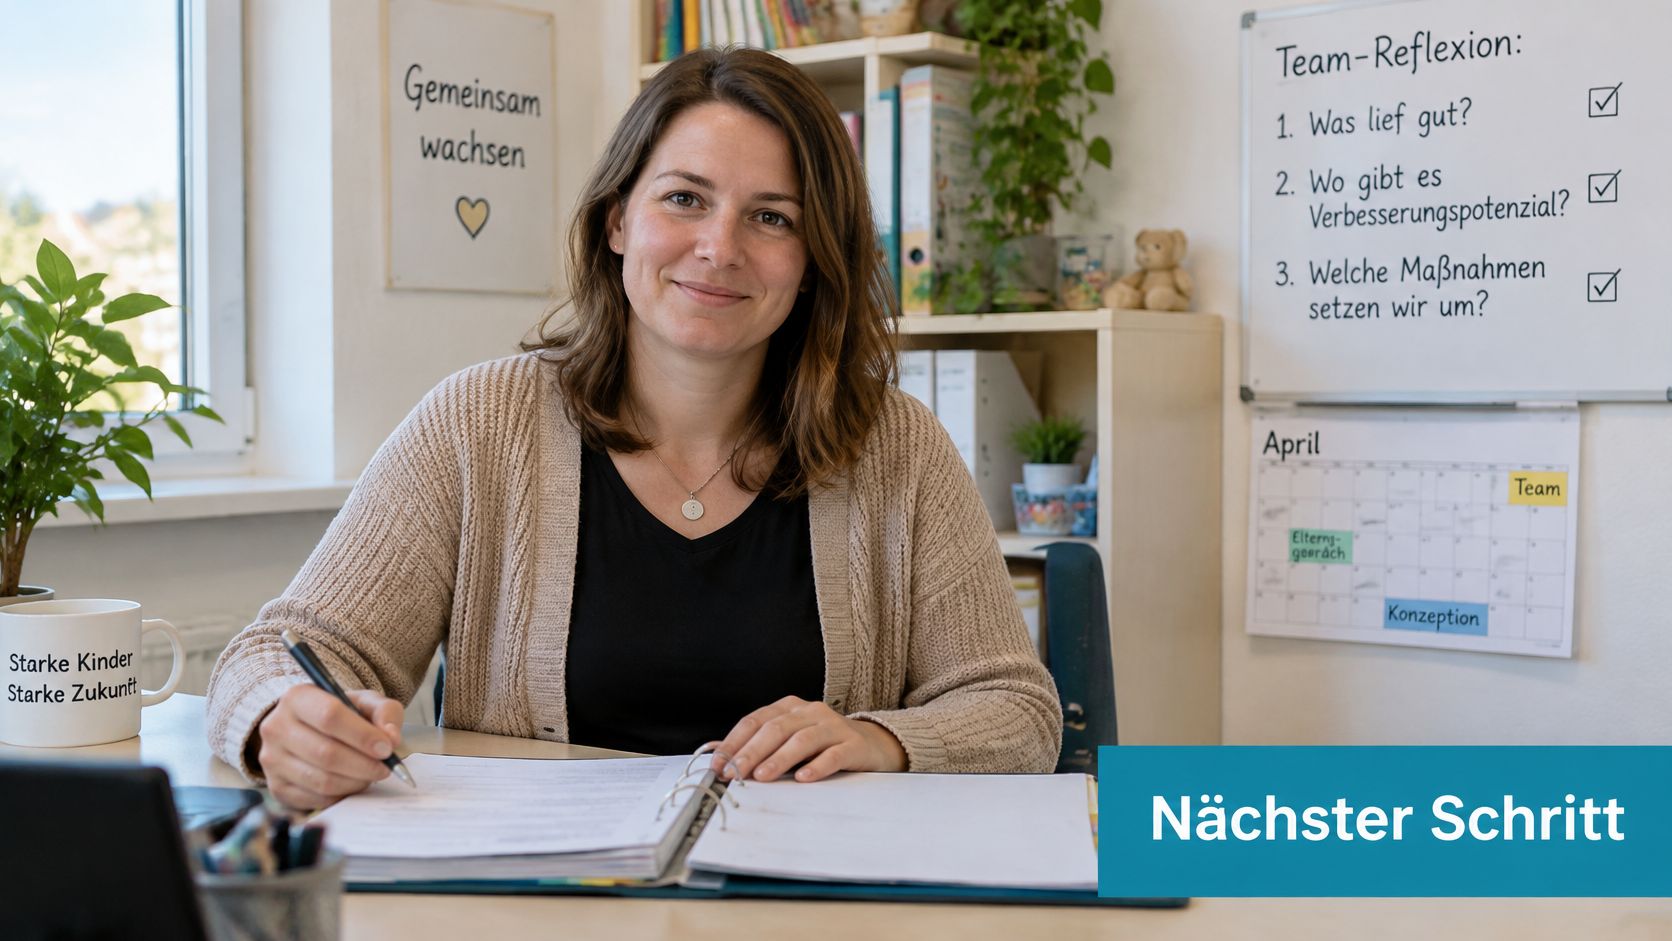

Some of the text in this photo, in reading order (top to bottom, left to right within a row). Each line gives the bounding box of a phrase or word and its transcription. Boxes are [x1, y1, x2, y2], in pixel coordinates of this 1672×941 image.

[1275, 30, 1522, 78] Team-Reflexion:
[404, 63, 541, 117] Gemeinsam
[1276, 96, 1473, 139] 1. Was lief gut?
[420, 129, 526, 169] wachsen
[1275, 163, 1442, 201] 2. Wo gibt es
[1309, 189, 1570, 231] Verbesserungspotenzial?
[1275, 254, 1546, 289] 3. Welche Maßnahmen
[1309, 290, 1489, 320] setzen wir um?
[1262, 430, 1320, 461] April
[1514, 477, 1561, 497] Team
[1388, 604, 1480, 632] Konzeption
[9, 649, 133, 673] Starke Kinder
[7, 684, 65, 704] Starke
